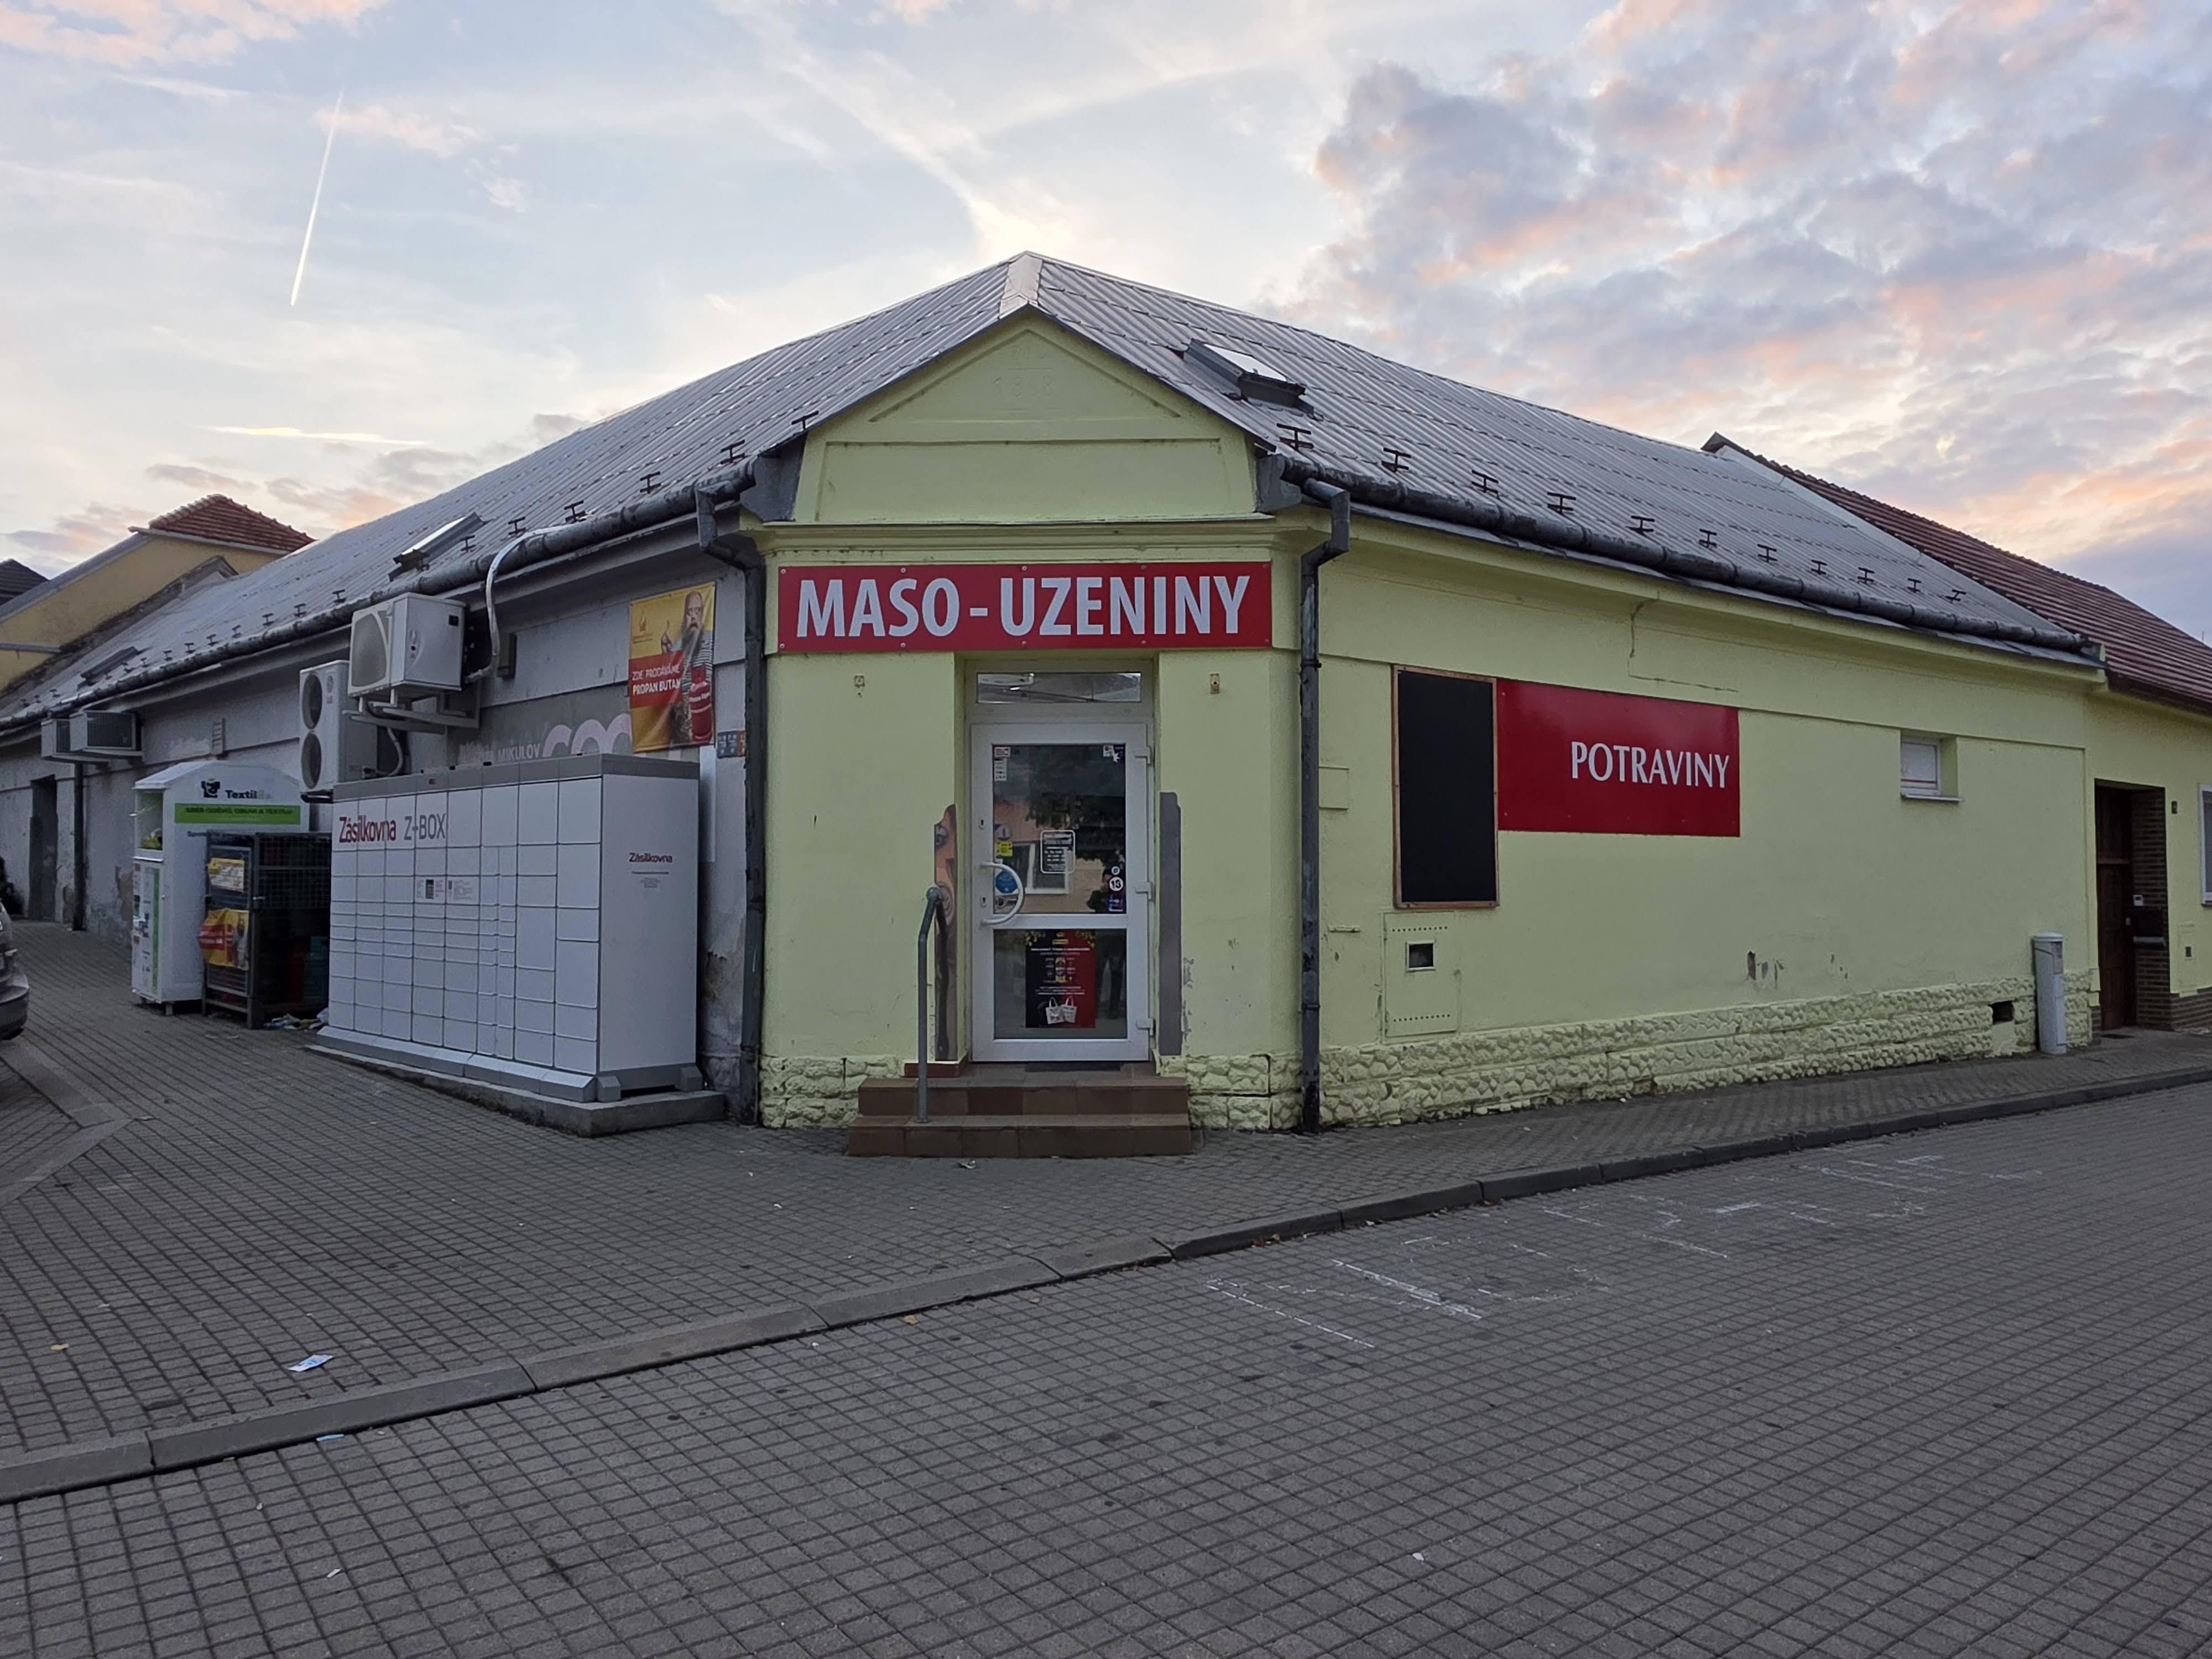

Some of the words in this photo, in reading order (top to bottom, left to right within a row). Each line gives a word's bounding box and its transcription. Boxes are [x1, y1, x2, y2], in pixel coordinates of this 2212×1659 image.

[796, 578, 959, 638] MASO
[969, 607, 988, 617] -
[1000, 576, 1250, 636] UZENINY
[633, 670, 644, 681] ZDE
[633, 681, 658, 696] PROPAN
[659, 678, 682, 692] BUTAN
[498, 743, 540, 761] MIKULOV
[1571, 741, 1729, 788] POTRAVINY
[339, 815, 397, 843] Zásilkovna
[404, 813, 446, 841] Z-BOX
[629, 852, 673, 863] Zásilkovna
